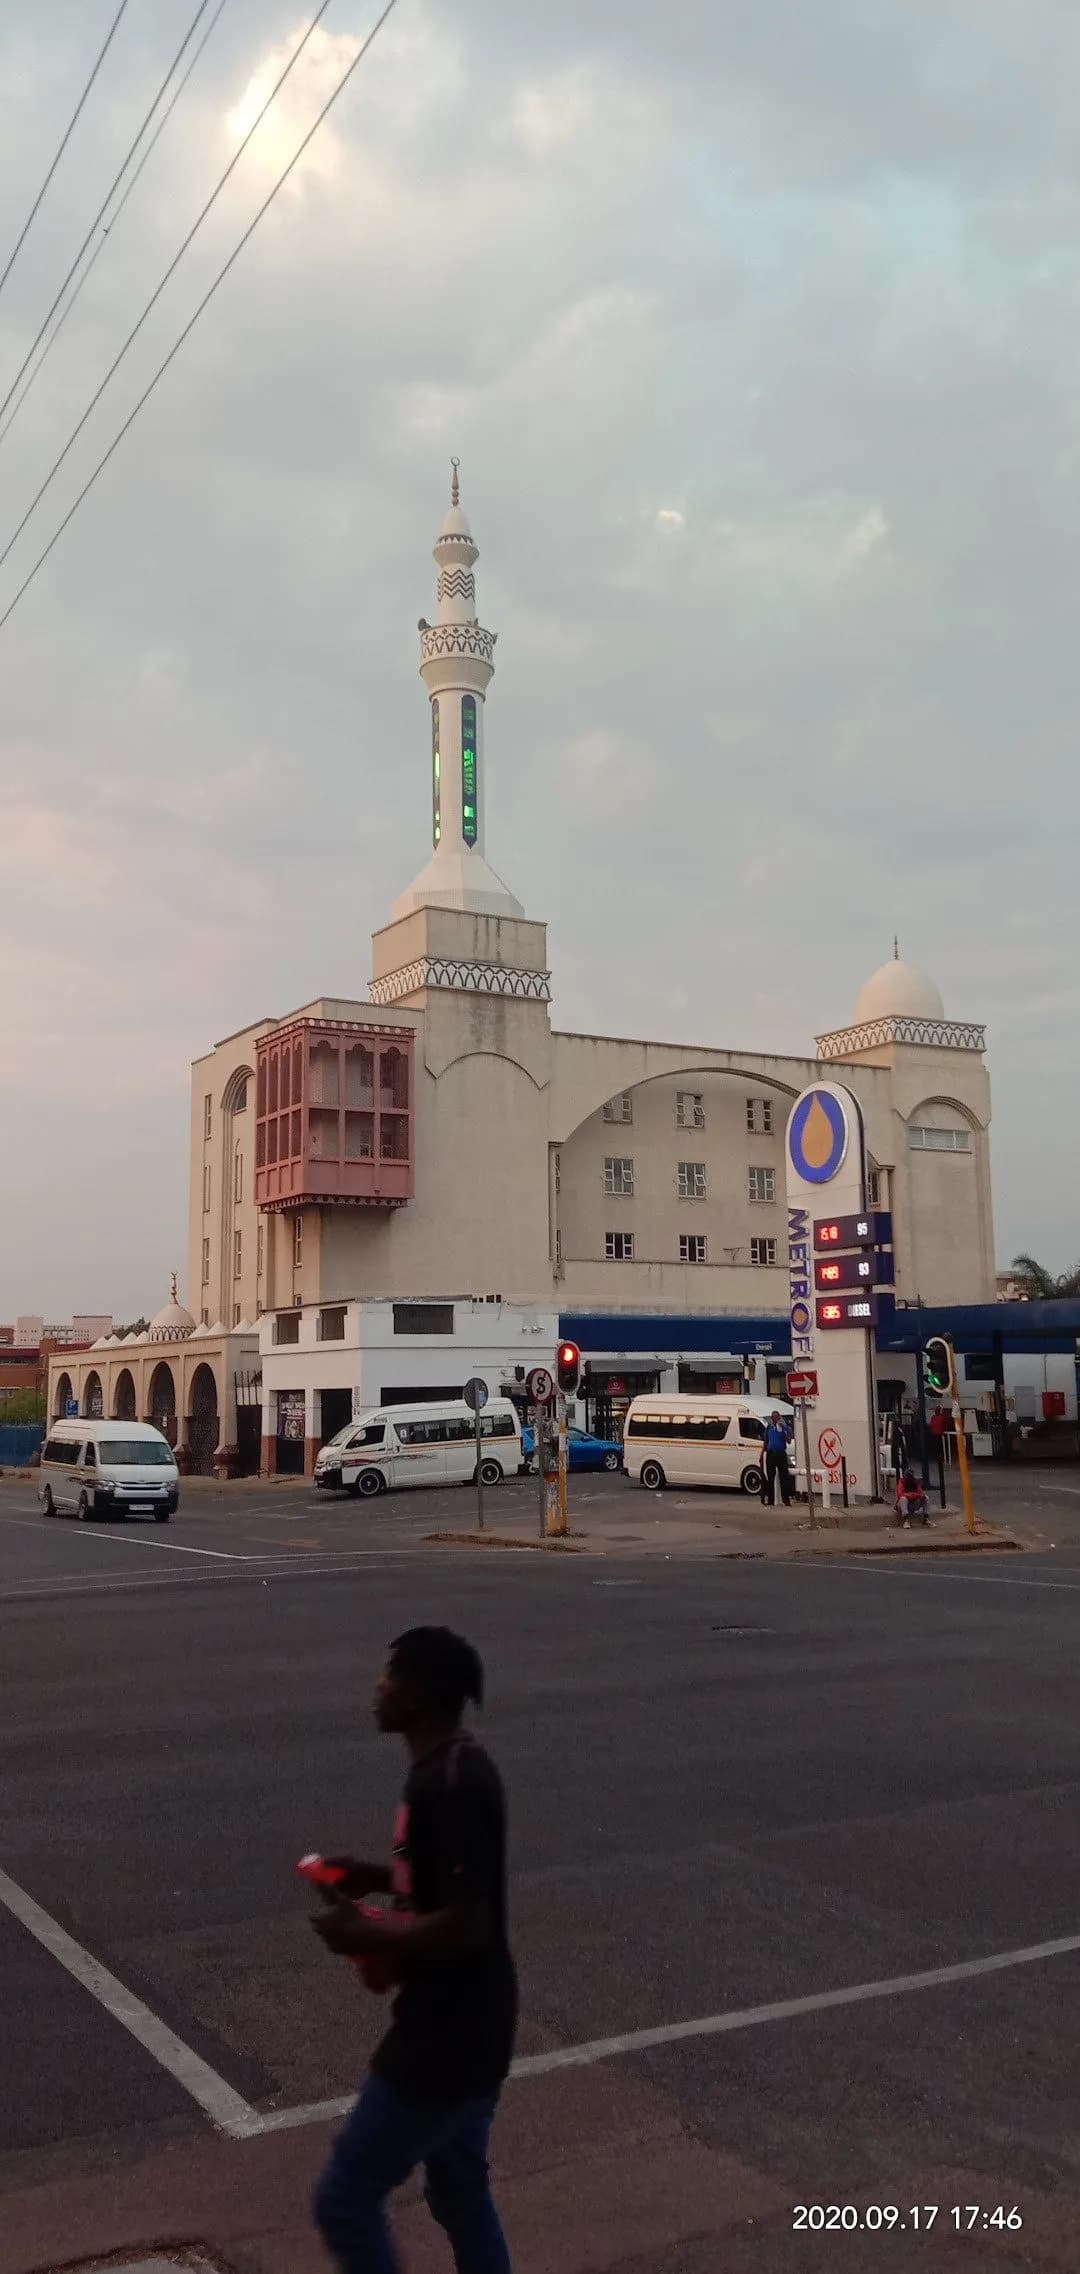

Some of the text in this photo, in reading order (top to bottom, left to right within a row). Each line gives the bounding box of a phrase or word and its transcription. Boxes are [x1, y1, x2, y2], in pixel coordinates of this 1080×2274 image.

[857, 1223, 868, 1236] 95
[858, 1262, 870, 1276] 93
[848, 1303, 871, 1317] DIESEL
